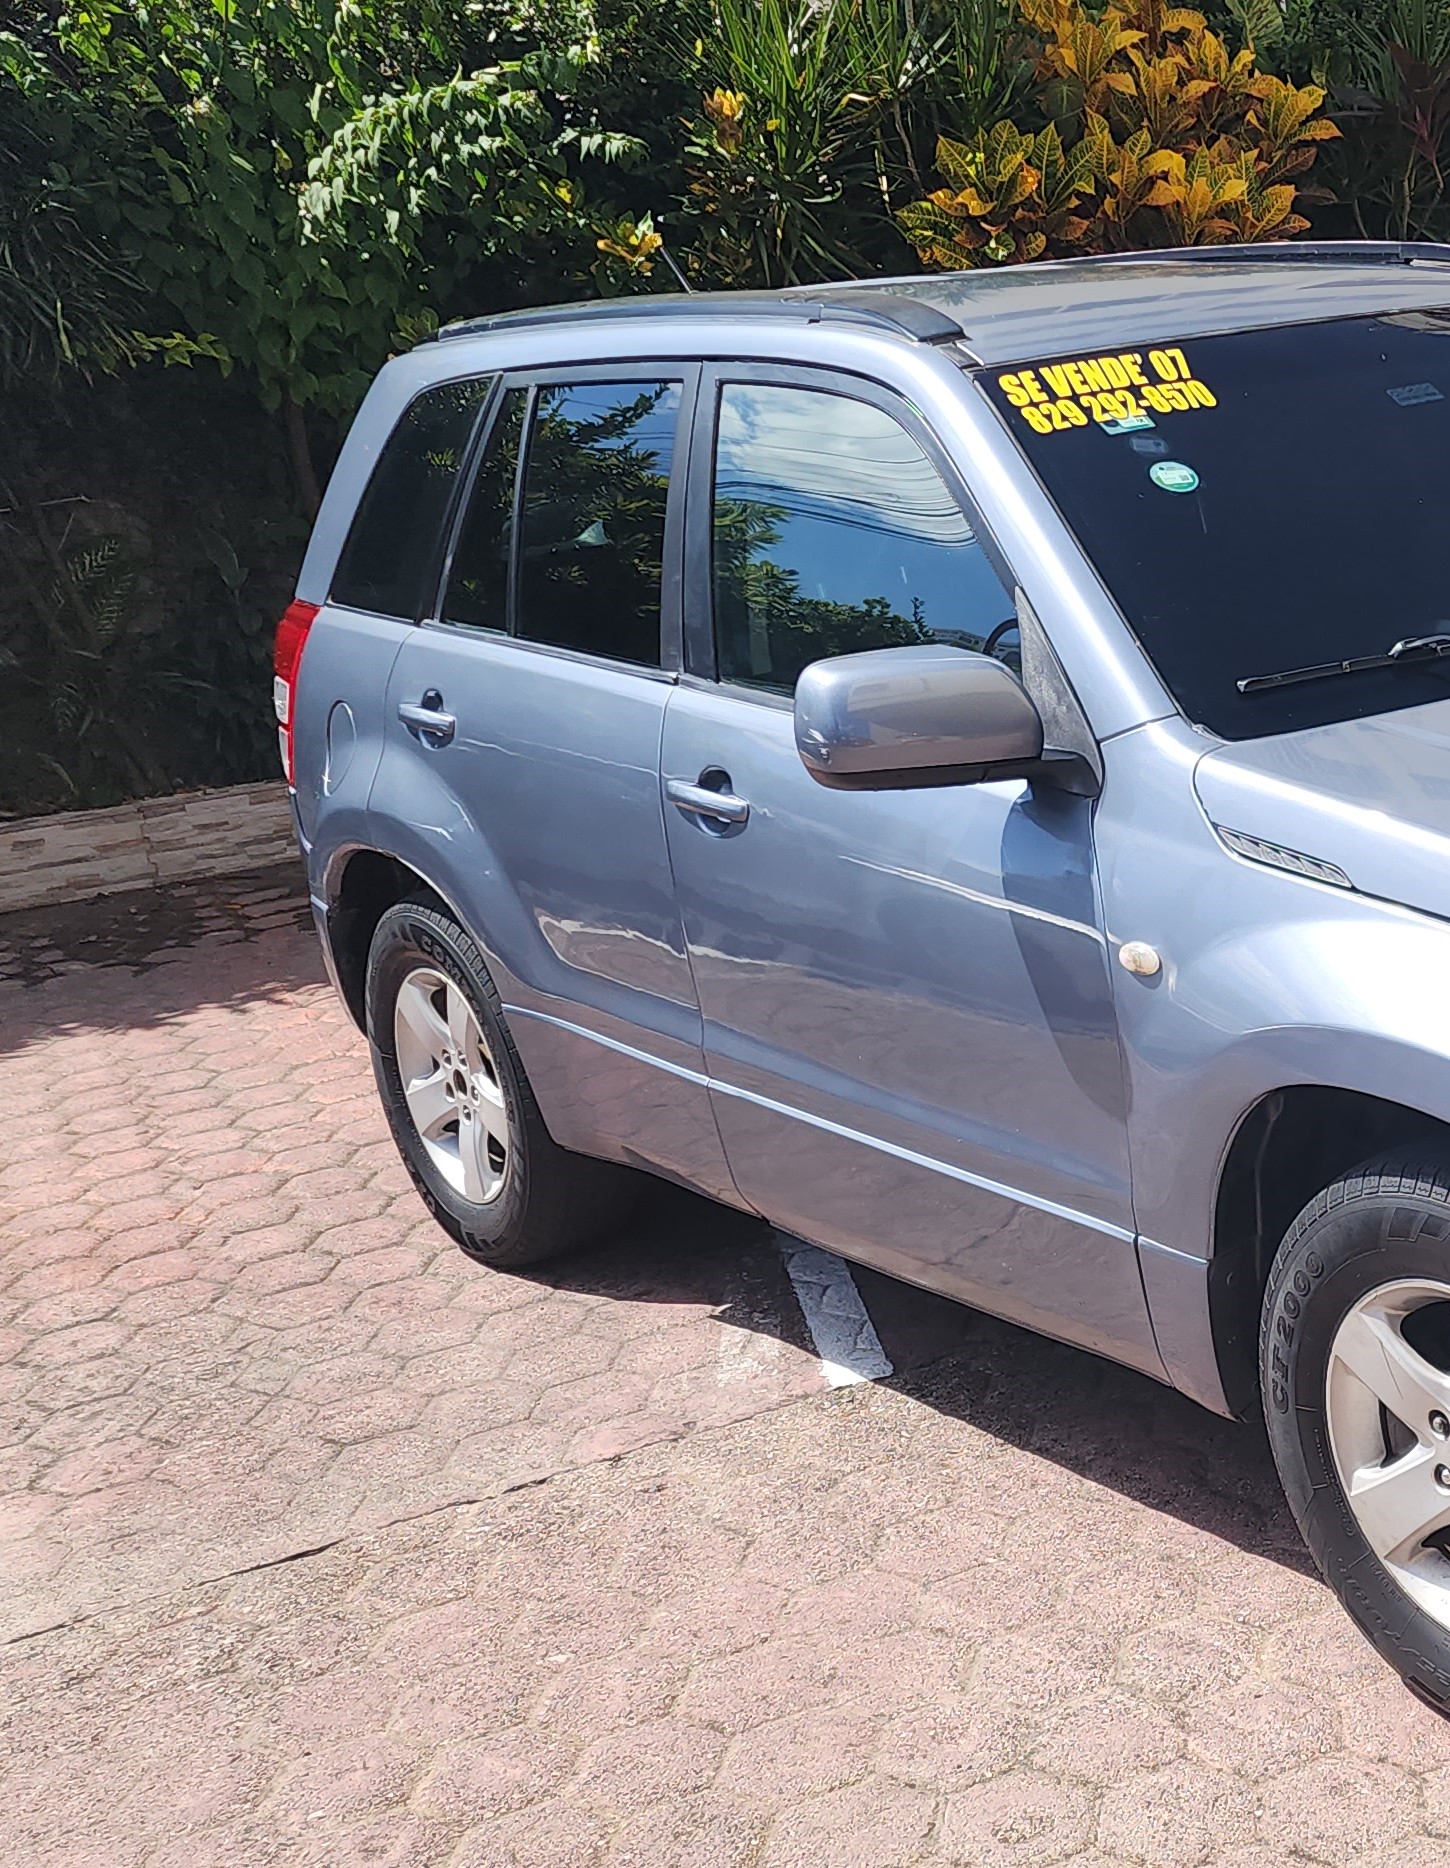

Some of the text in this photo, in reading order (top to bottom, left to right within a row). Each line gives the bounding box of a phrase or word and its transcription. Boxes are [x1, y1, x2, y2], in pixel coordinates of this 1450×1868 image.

[998, 369, 1050, 407] SE
[1148, 348, 1192, 382] 07
[1020, 380, 1218, 434] 829 292-8570
